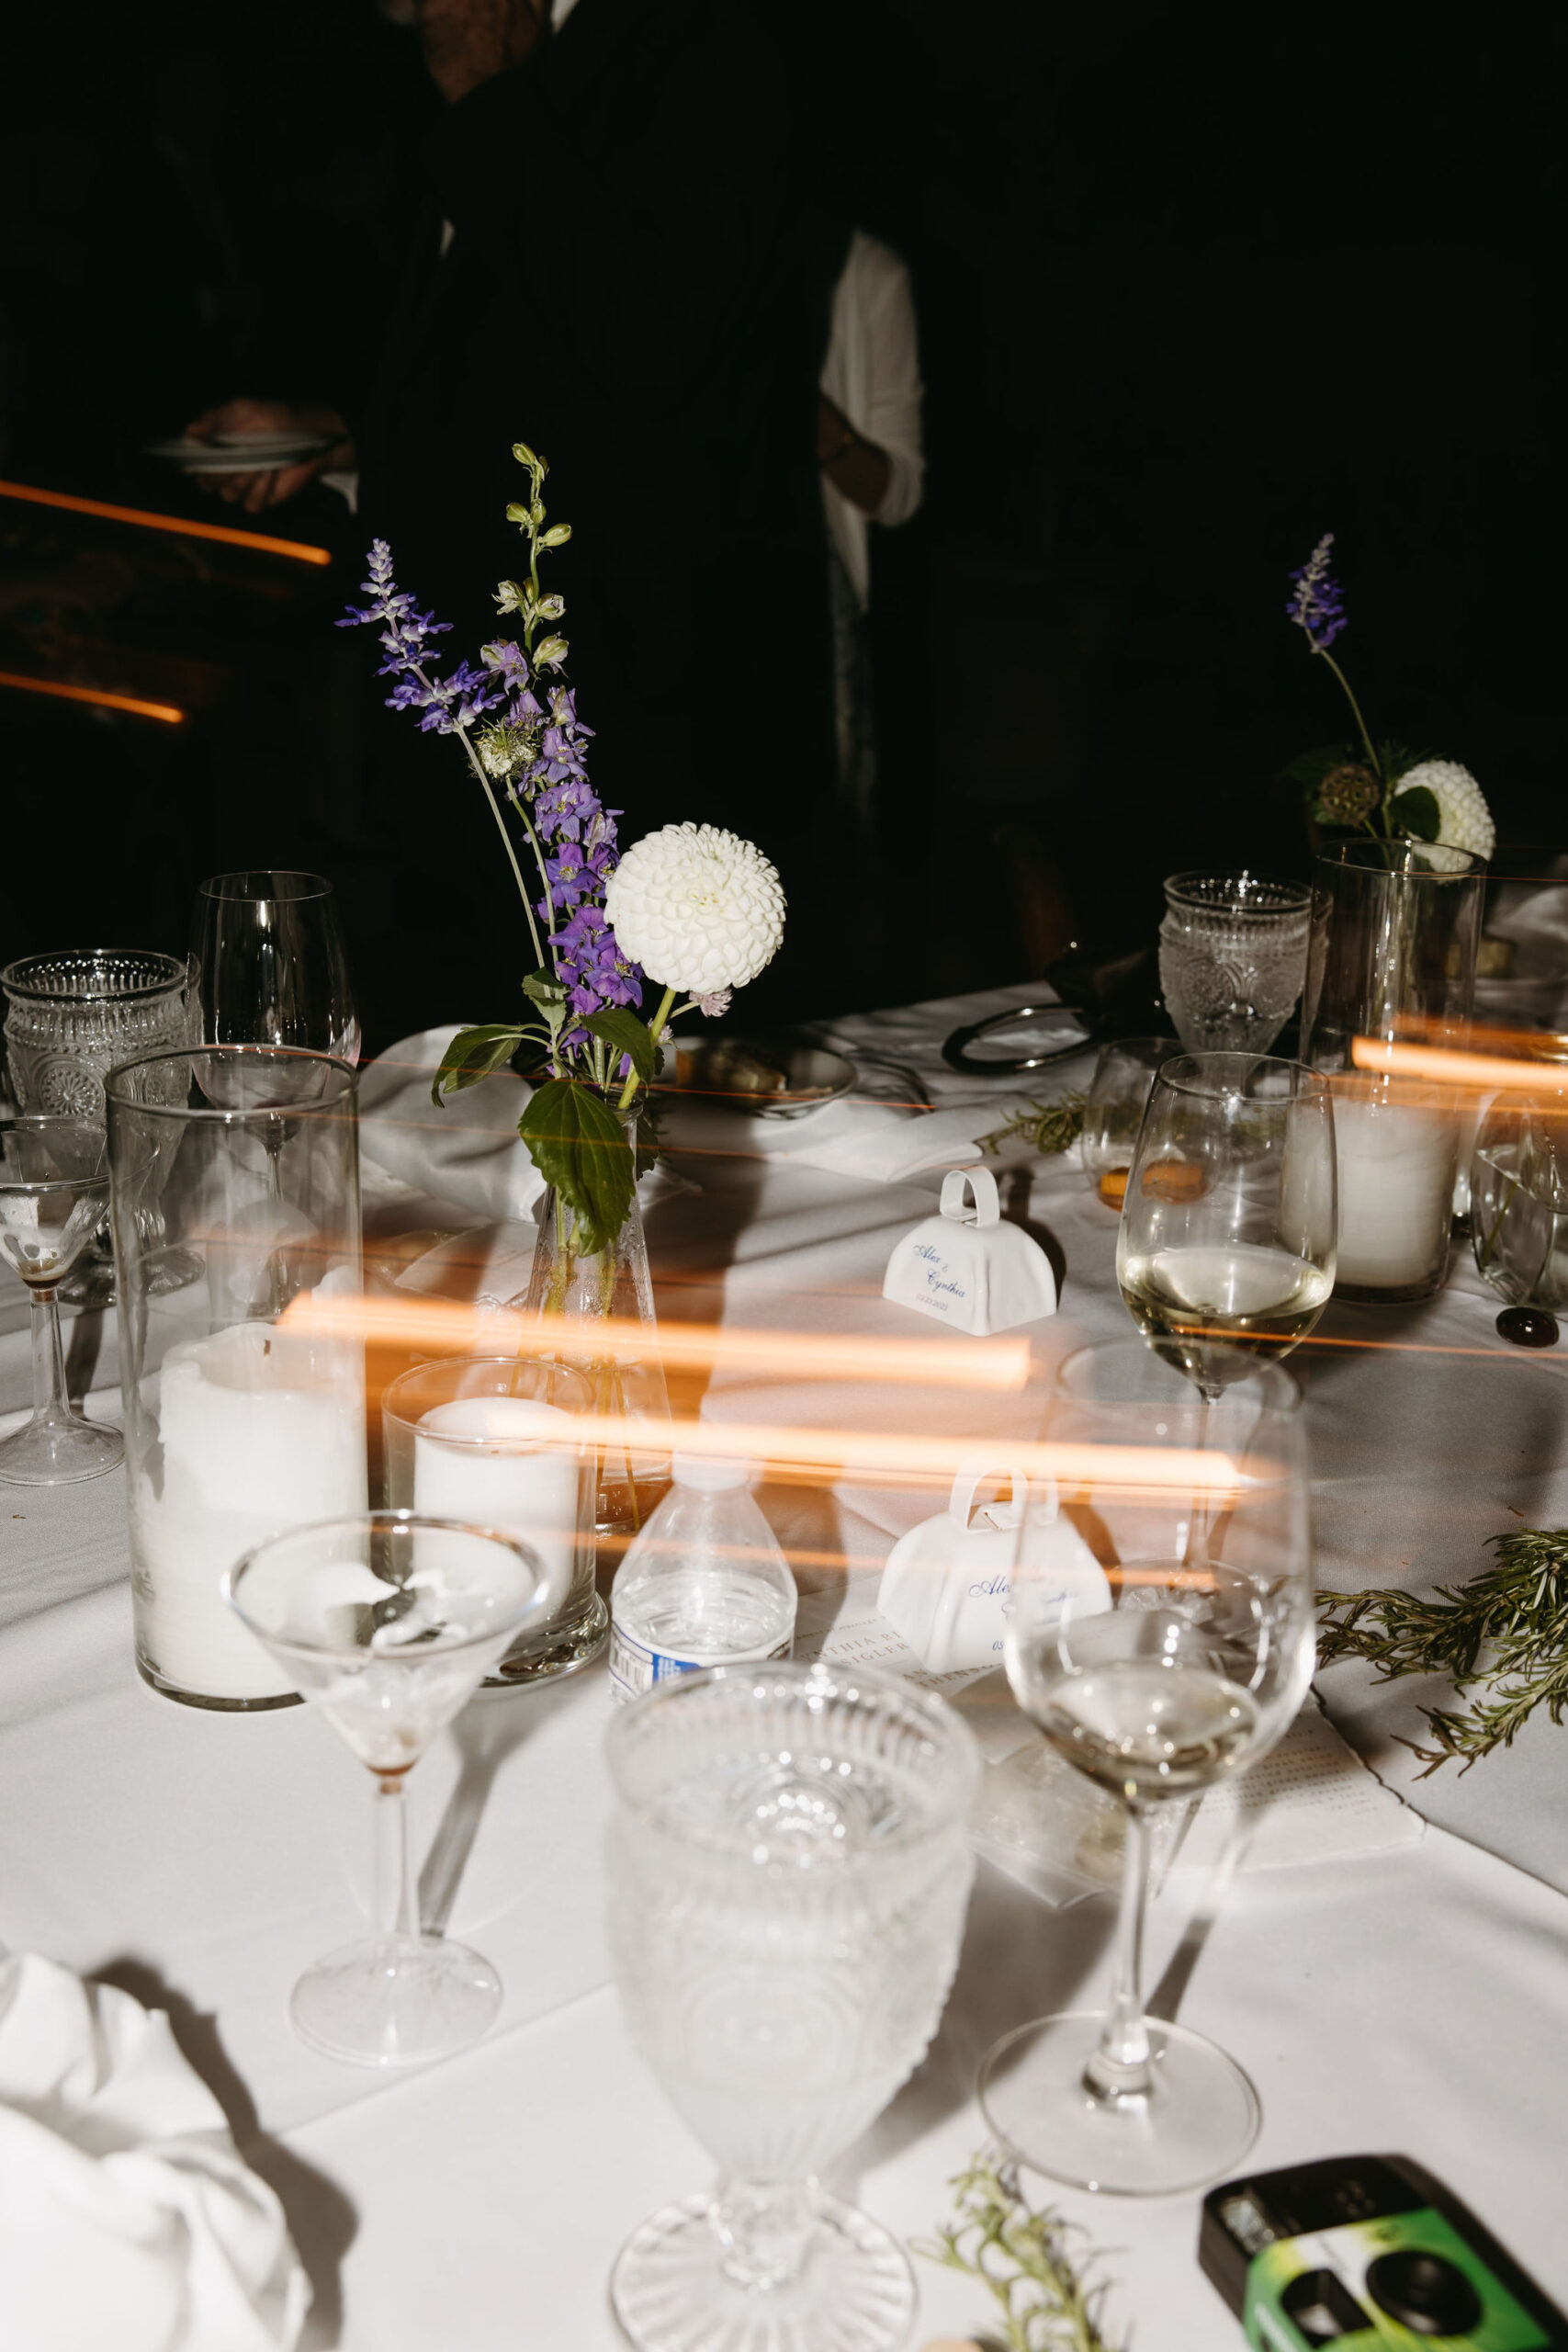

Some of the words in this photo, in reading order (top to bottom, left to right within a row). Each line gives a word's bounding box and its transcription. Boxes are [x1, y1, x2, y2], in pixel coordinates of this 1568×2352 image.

[913, 1245, 941, 1263] Alex
[927, 1269, 966, 1298] Cynthia
[801, 1638, 875, 1663] YNTHIA
